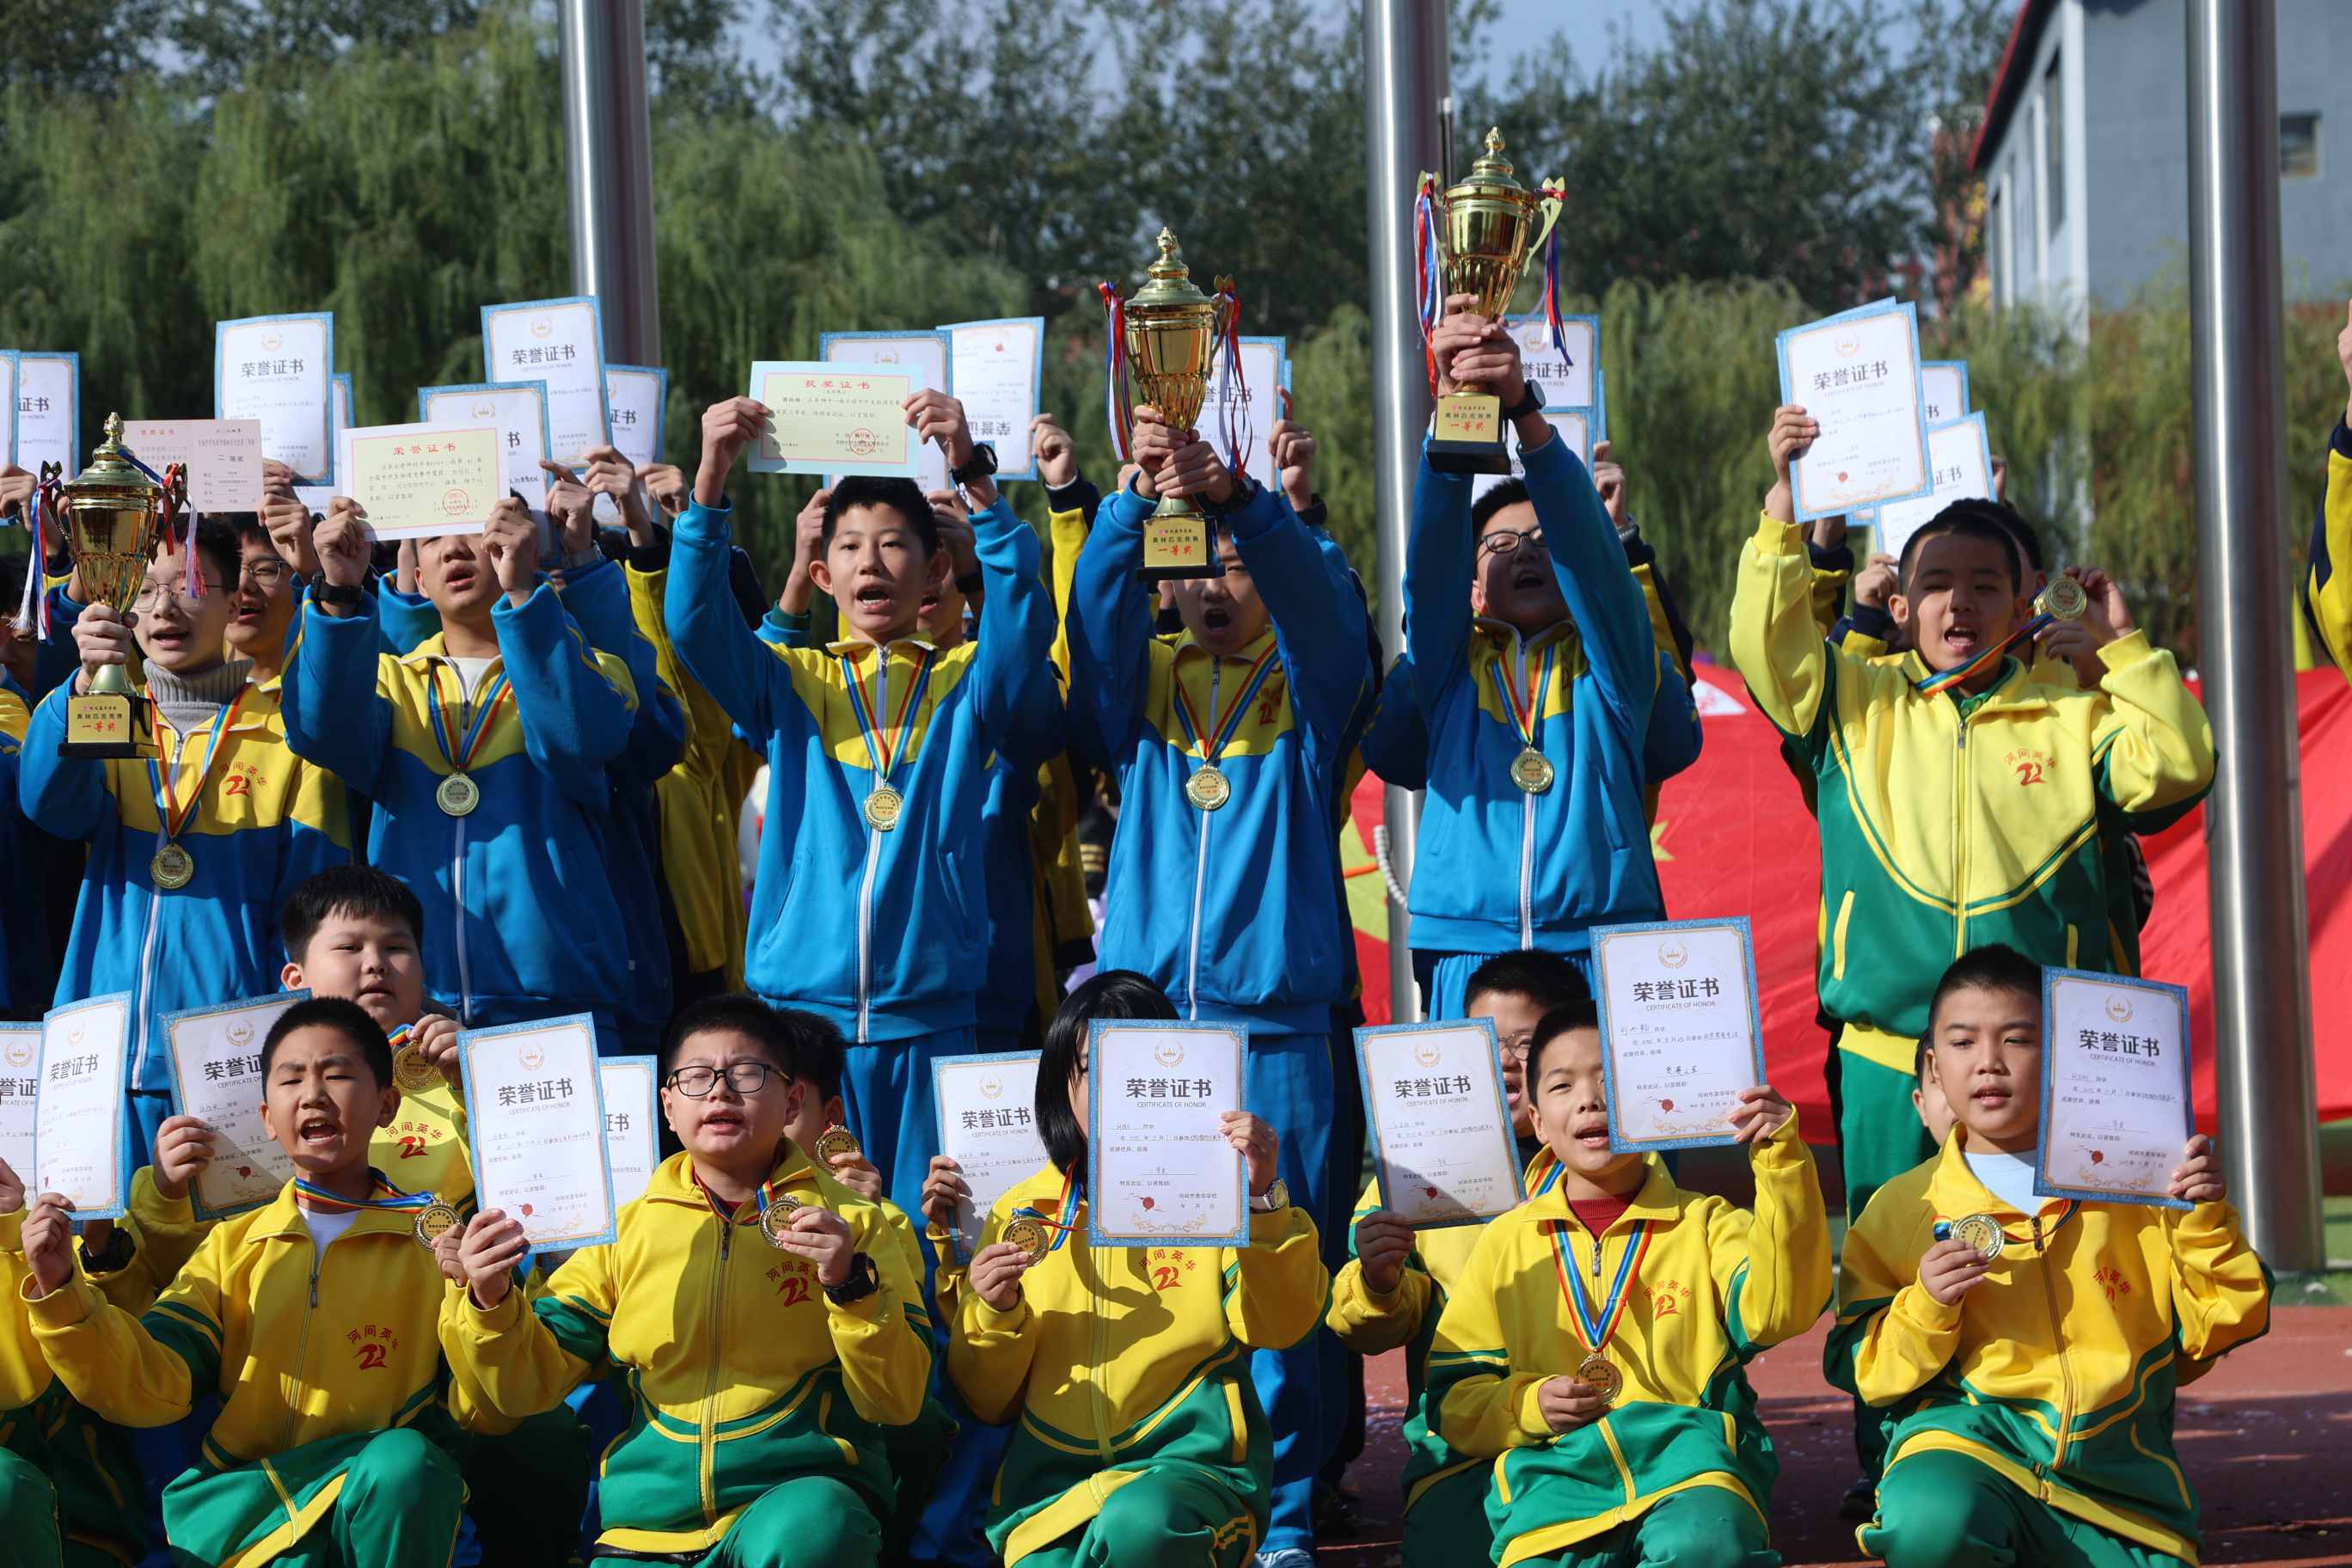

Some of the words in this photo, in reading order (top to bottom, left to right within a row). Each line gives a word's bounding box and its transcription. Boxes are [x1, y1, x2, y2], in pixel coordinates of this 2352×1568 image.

[512, 344, 576, 365] 荣誉证书
[241, 358, 303, 378] 荣誉证书
[1813, 359, 1889, 391] 荣誉证书
[1450, 420, 1485, 432] 一等奖
[393, 443, 456, 456] 荣誉证书
[507, 431, 521, 448] 书
[1158, 544, 1193, 556] 一等奖
[82, 720, 117, 732] 一等奖
[1633, 977, 1719, 1002] 荣誉证书
[2079, 1029, 2160, 1057] 荣誉证书
[50, 1054, 99, 1083] 荣誉证书
[204, 1053, 262, 1081] 荣誉证
[498, 1078, 573, 1106] 荣誉证书
[1126, 1078, 1212, 1099] 荣誉证书
[1394, 1075, 1471, 1099] 荣誉证书
[962, 1106, 1032, 1130] 荣誉证书
[385, 1121, 444, 1140] 河间英华
[1139, 1249, 1197, 1271] 河间英华
